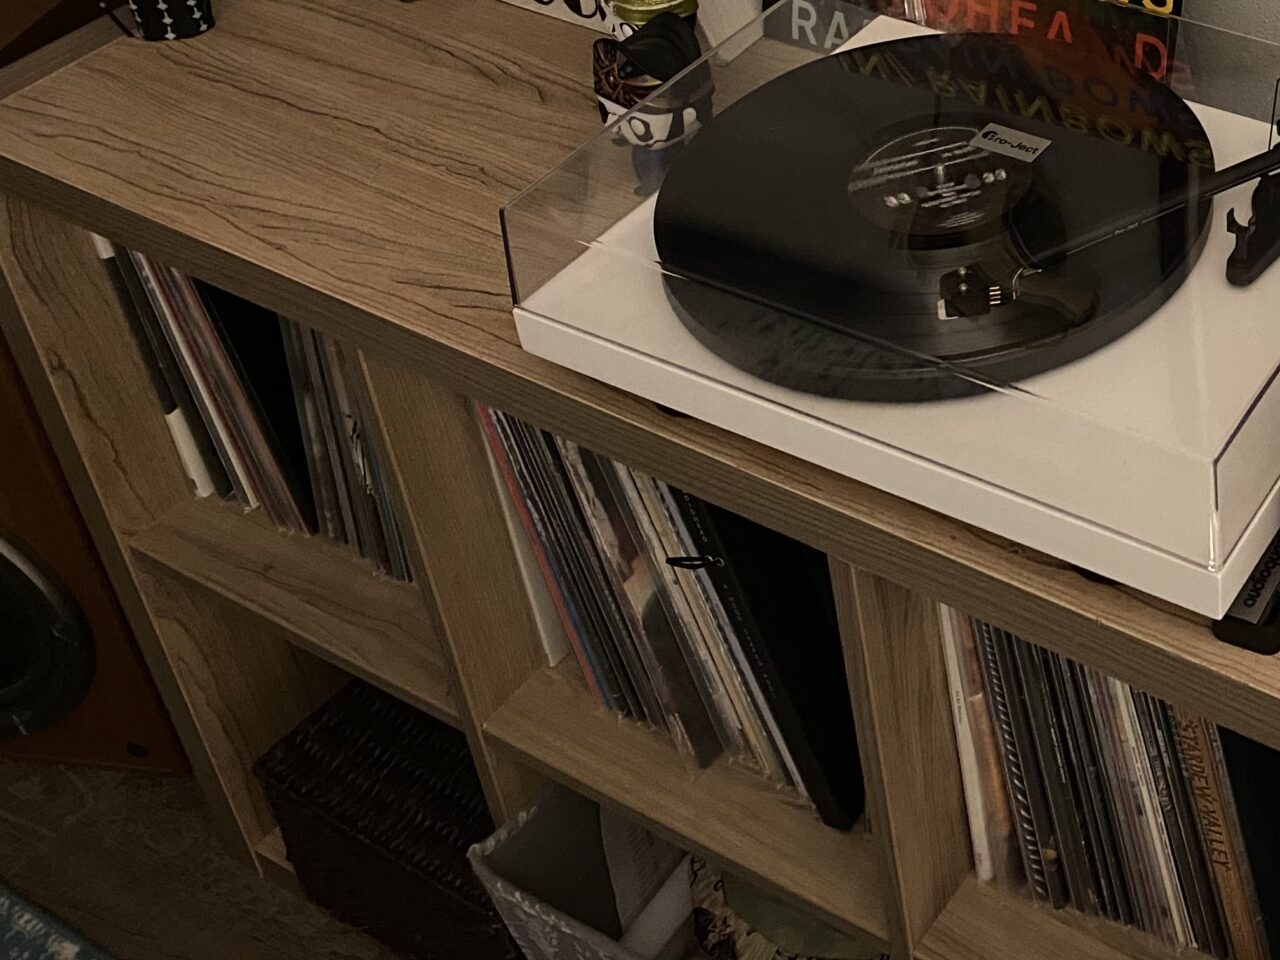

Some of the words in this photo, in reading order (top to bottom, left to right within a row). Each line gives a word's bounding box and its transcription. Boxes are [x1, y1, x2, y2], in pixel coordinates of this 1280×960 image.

[981, 129, 1039, 156] Pro-Ject
[1179, 719, 1215, 806] STARDEW
[1202, 804, 1232, 872] VALLEY
